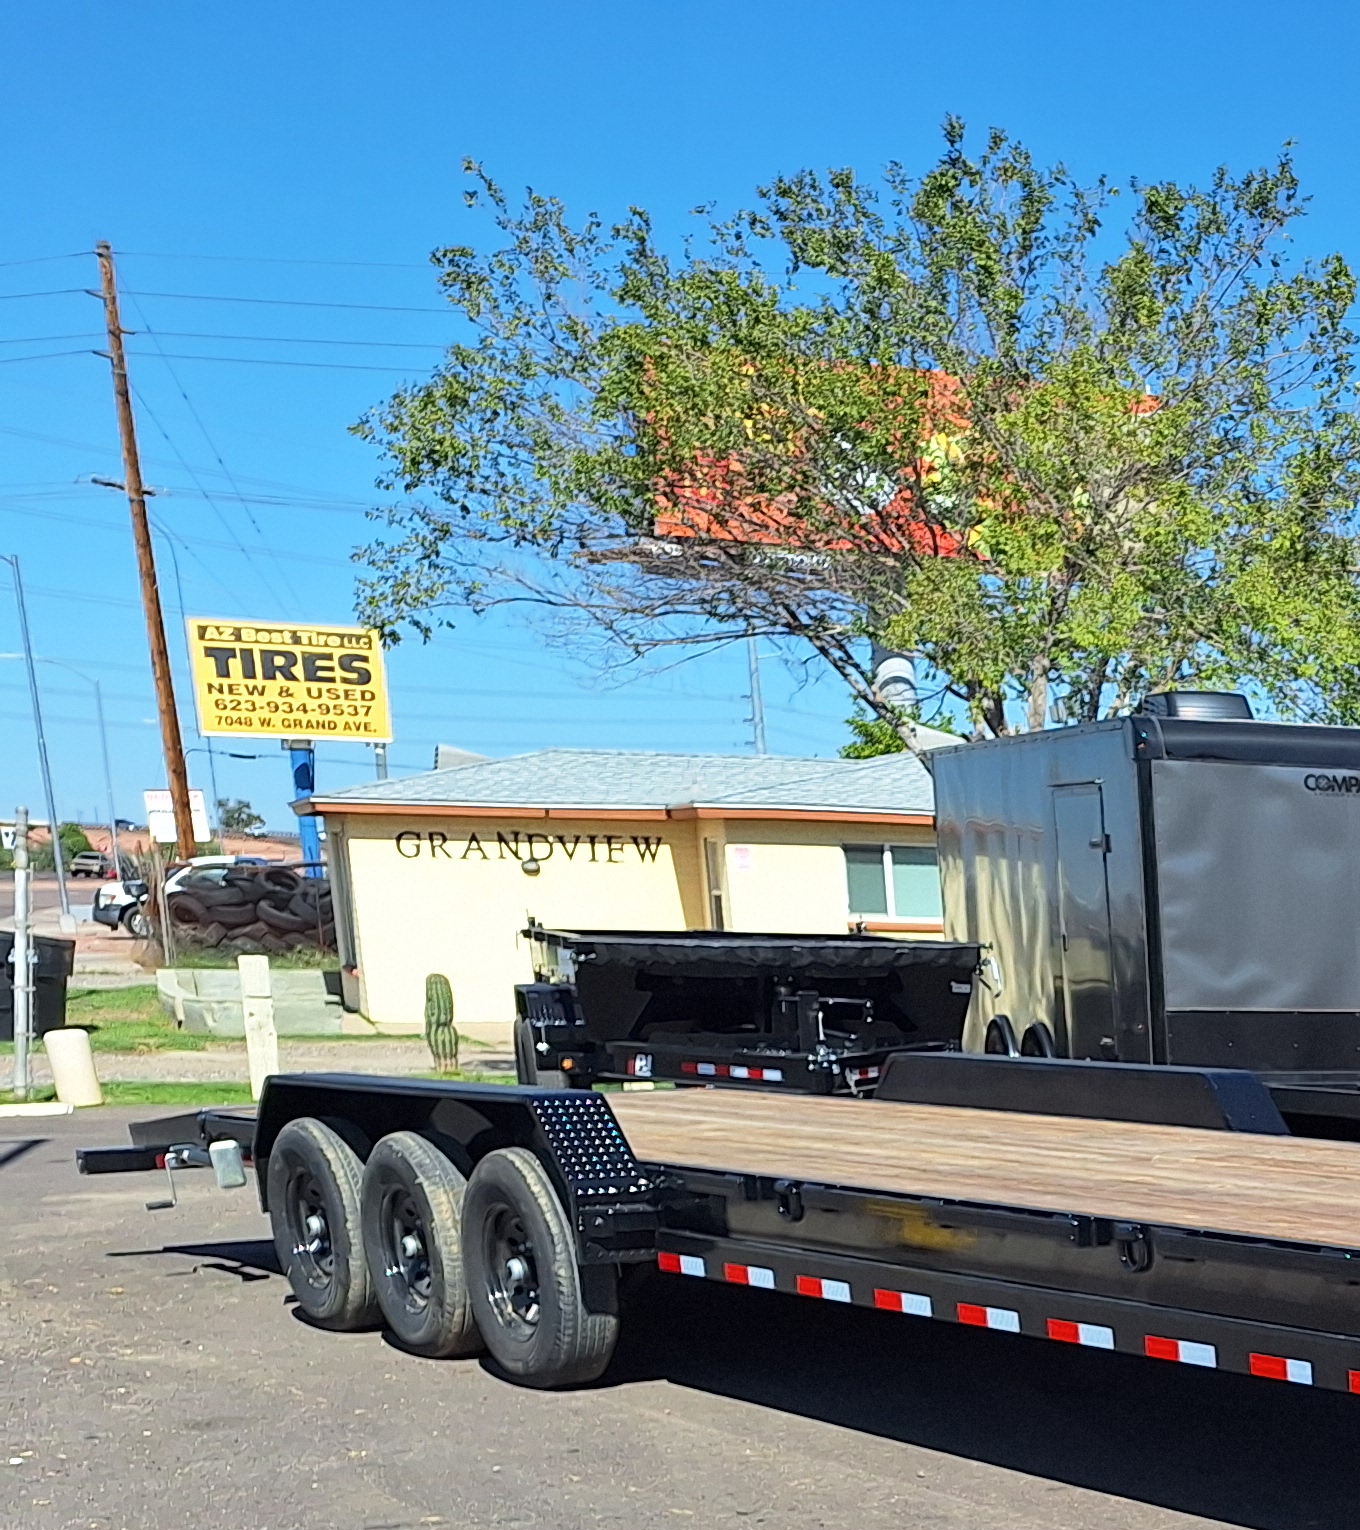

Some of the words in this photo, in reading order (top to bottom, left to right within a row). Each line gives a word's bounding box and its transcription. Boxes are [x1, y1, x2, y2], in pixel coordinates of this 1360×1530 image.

[204, 625, 235, 641] AZ
[241, 627, 293, 645] Best
[296, 630, 341, 648] Tire
[344, 635, 370, 649] LLC
[204, 646, 372, 686] TIRES
[207, 682, 266, 697] NEW
[278, 685, 294, 698] &
[306, 686, 376, 702] USED
[215, 698, 372, 717] 623-934-9537
[216, 715, 253, 728] 7048
[258, 717, 276, 728] W.
[281, 718, 337, 731] GRAND
[342, 721, 377, 733] AVE.
[394, 830, 663, 863] GRANDVIEW
